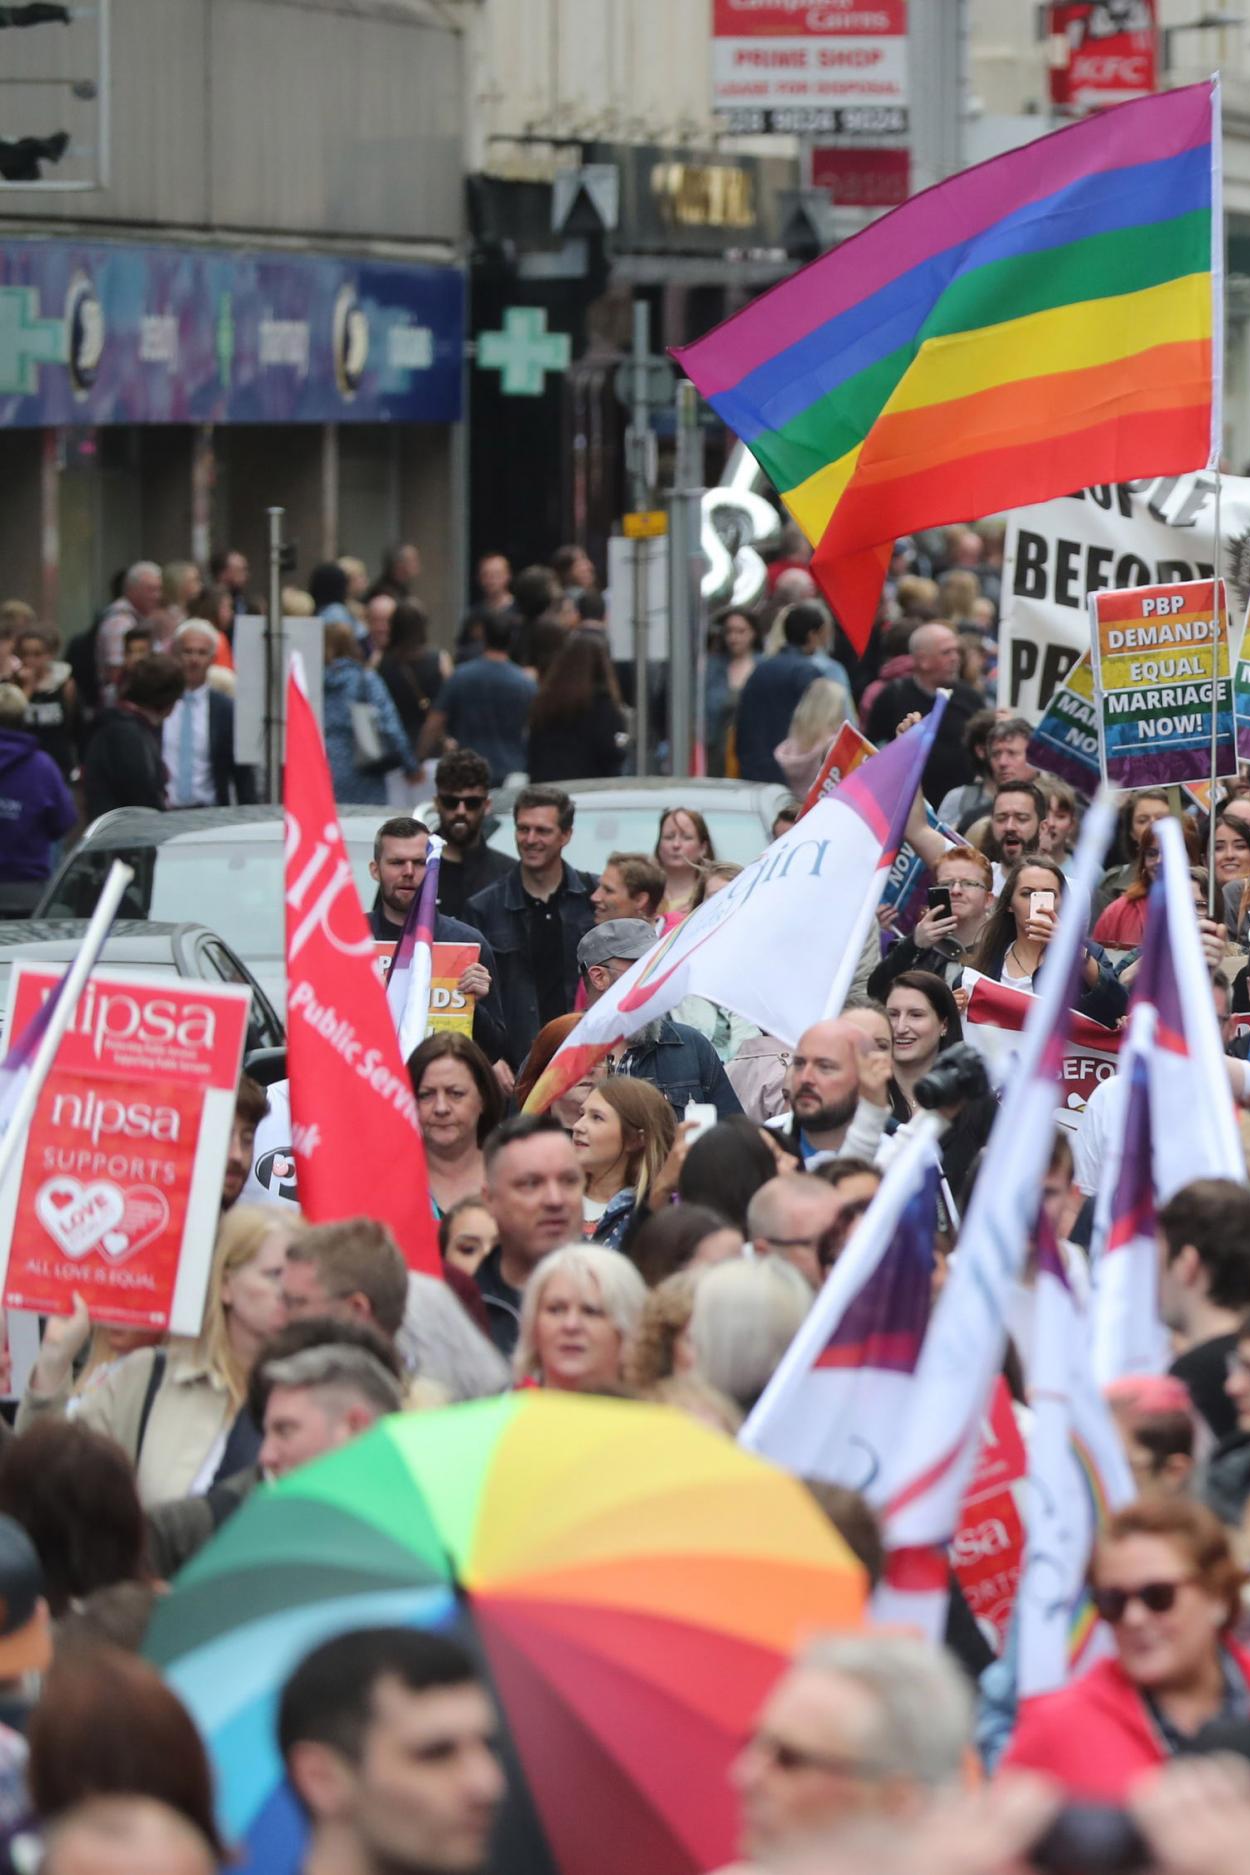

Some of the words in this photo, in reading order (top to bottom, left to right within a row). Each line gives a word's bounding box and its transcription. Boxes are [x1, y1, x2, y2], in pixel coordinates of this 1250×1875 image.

[733, 48, 808, 68] PRIME
[818, 48, 884, 68] SHOP
[1072, 56, 1149, 83] KFC
[1141, 595, 1185, 617] PBP
[1108, 620, 1222, 649] DEMANDS
[1130, 657, 1206, 684] EQUAL
[1108, 682, 1228, 714] MARRIAGE
[1138, 714, 1204, 738] NOW!
[1064, 727, 1099, 754] NO
[289, 979, 362, 1065] Public
[1057, 1058, 1117, 1083] EFO
[52, 1090, 180, 1148] nipsa
[43, 1146, 176, 1185] SUPPORTS
[54, 1262, 90, 1282] LOVE
